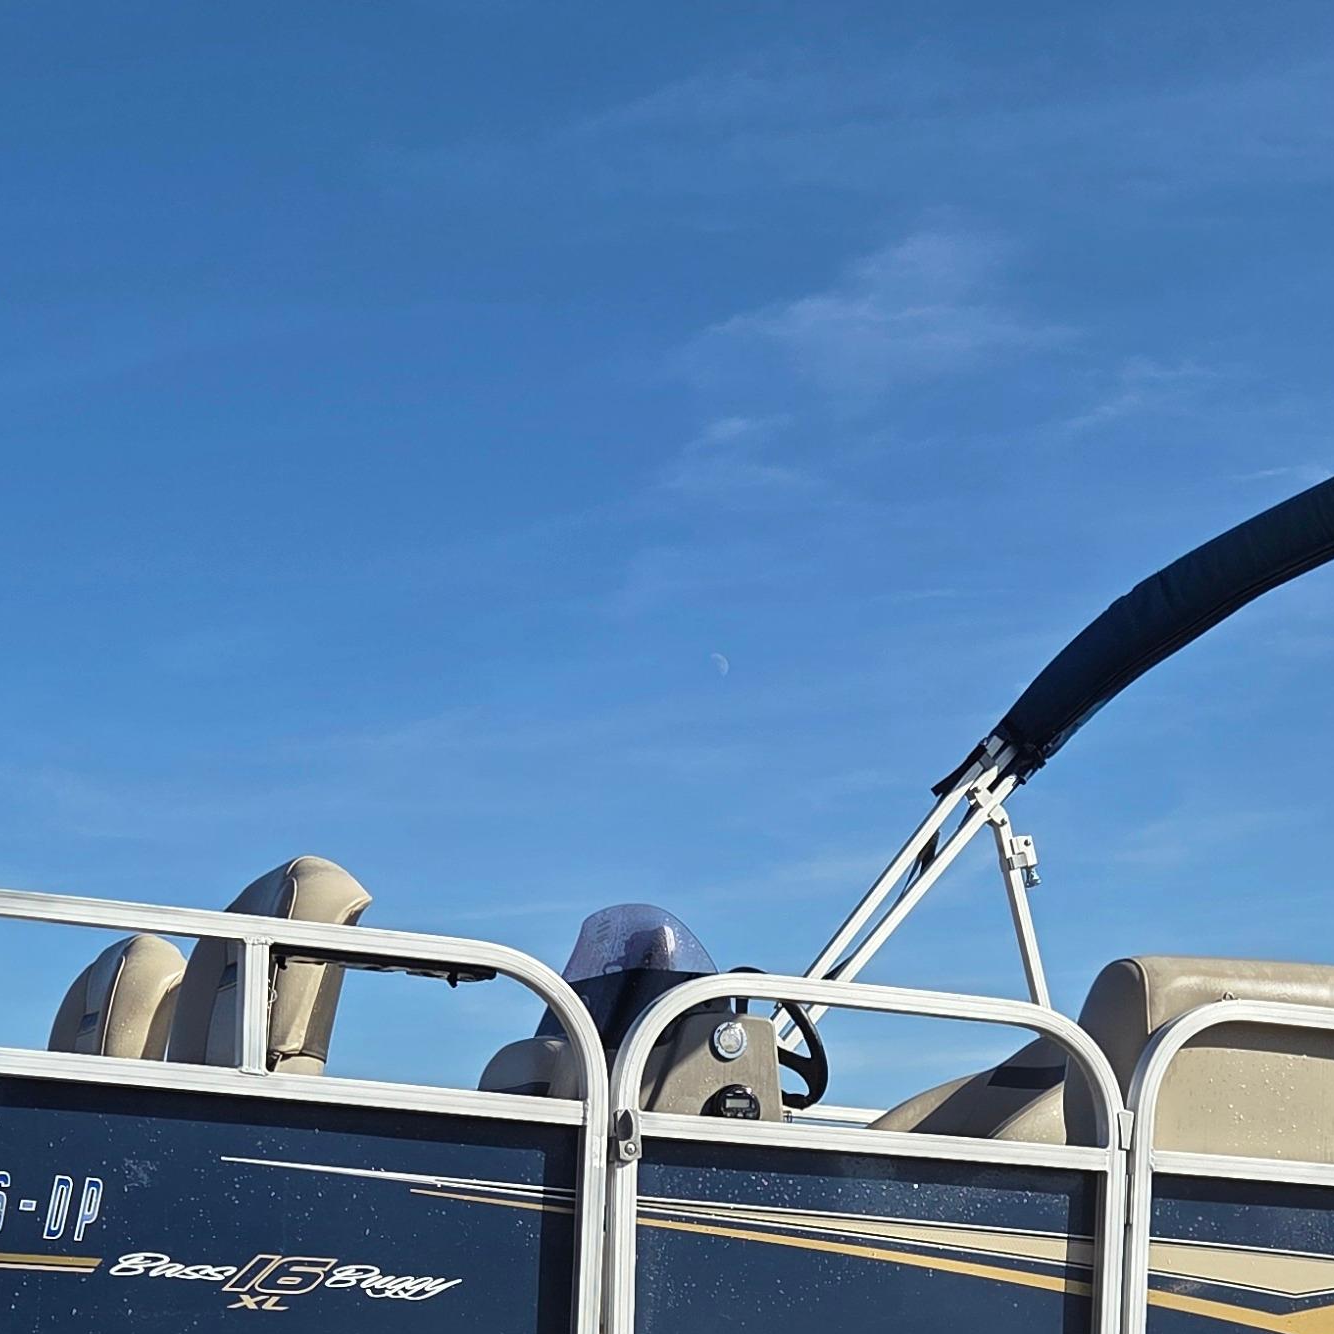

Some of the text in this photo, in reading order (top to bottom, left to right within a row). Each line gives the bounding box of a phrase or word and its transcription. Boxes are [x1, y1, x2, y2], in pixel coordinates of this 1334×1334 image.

[109, 1252, 463, 1301] Bass 16 Buggy
[226, 1294, 289, 1311] XL
